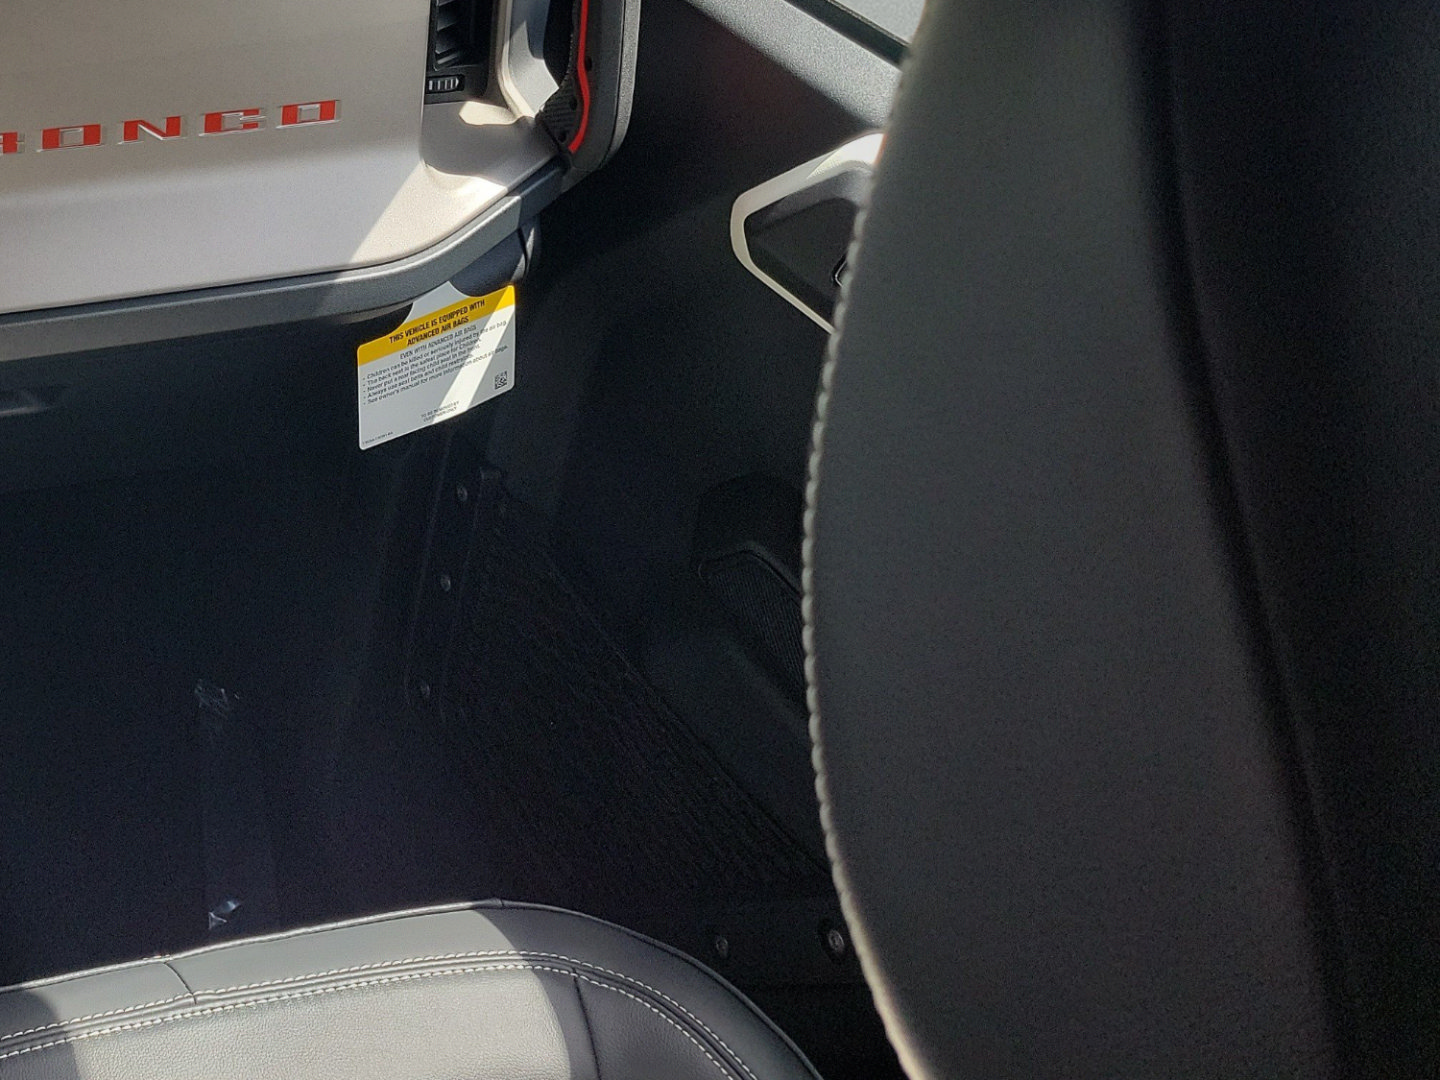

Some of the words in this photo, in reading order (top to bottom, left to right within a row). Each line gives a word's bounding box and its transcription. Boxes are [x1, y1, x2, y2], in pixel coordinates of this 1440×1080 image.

[389, 332, 403, 343] THIS
[404, 322, 429, 337] VEHICLE
[431, 318, 437, 326] IS
[438, 306, 467, 323] EQUIPPED
[469, 300, 484, 310] WITH
[407, 328, 439, 345] ADVANCED
[441, 323, 451, 331] AIR
[453, 316, 468, 327] BAGS
